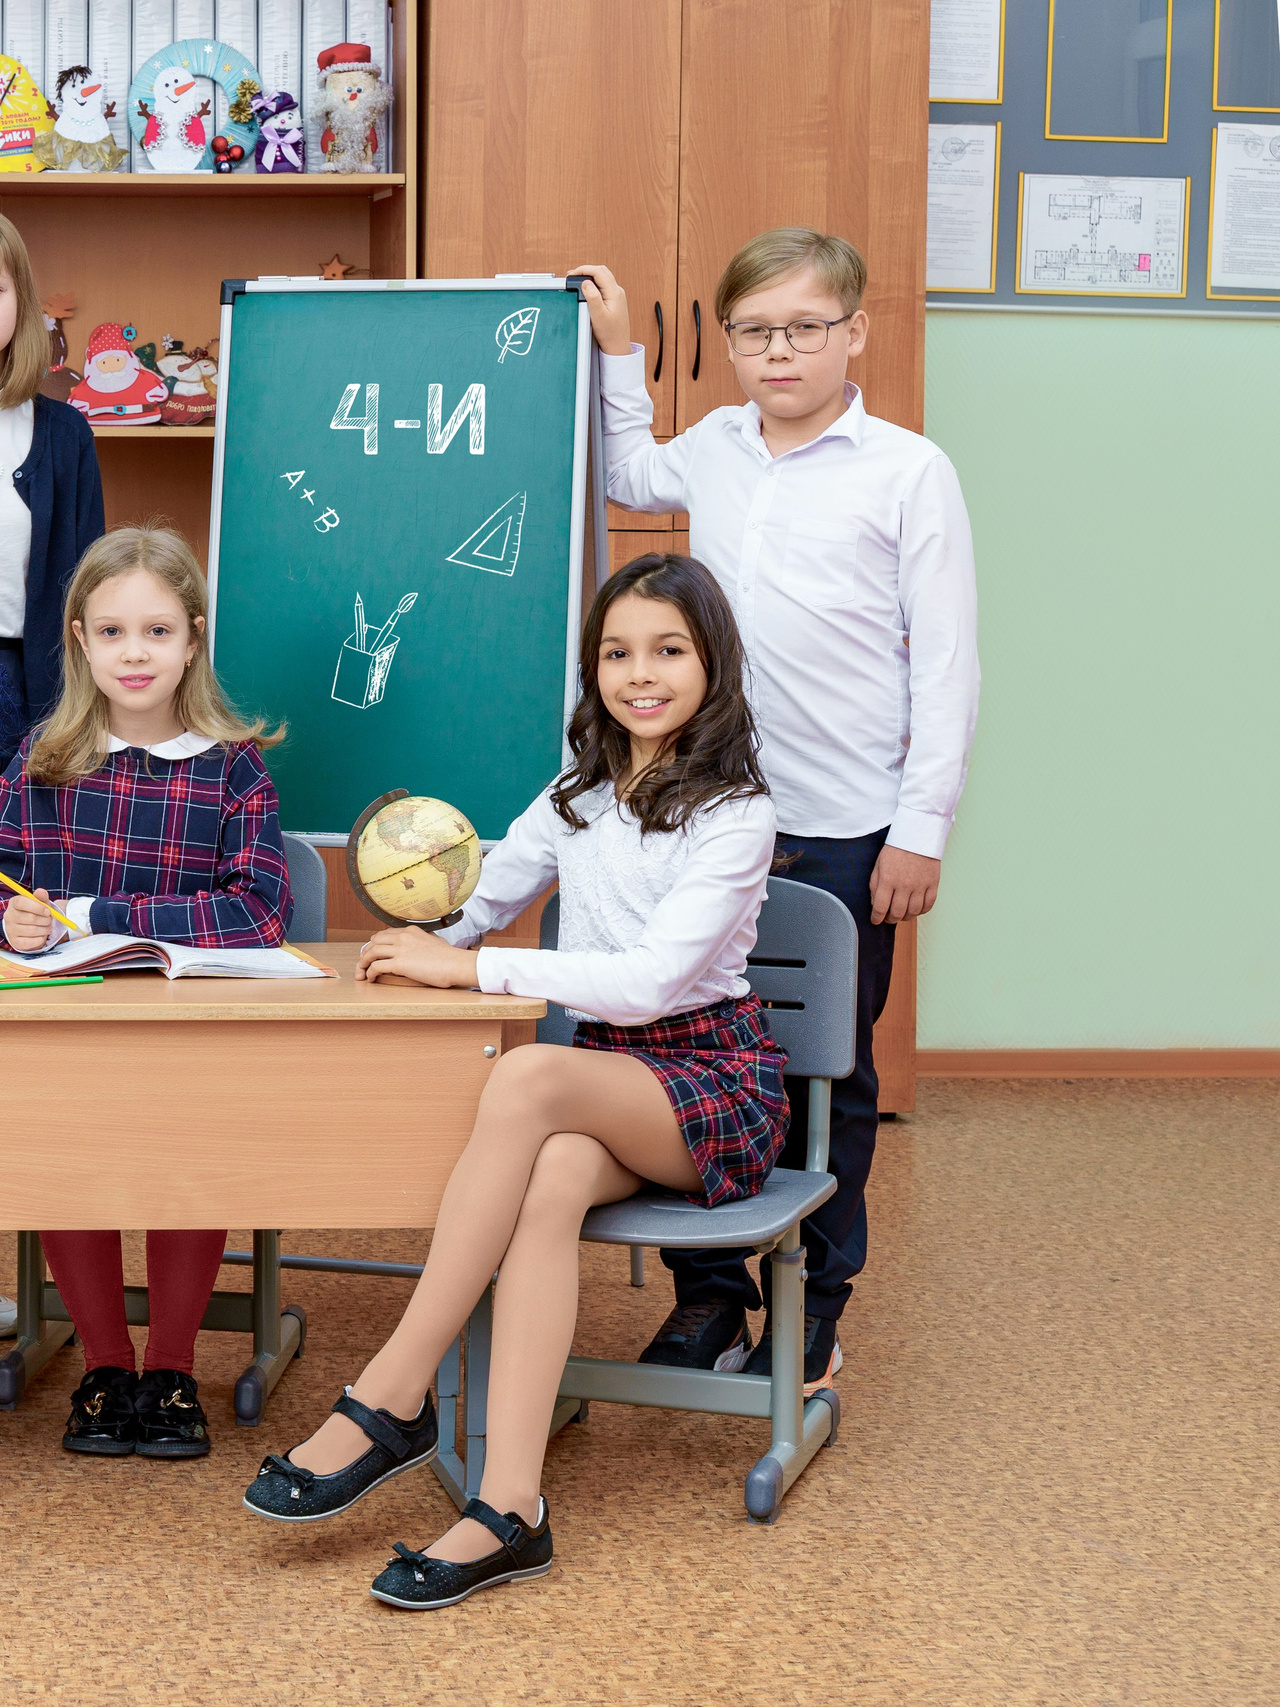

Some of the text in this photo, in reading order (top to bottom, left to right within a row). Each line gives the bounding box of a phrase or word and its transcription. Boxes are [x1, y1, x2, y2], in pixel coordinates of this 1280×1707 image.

[17, 67, 22, 75] 1
[31, 87, 38, 97] 2
[25, 163, 32, 172] 5
[166, 400, 216, 413] ДОБРО ПОЖАЛОВАТ
